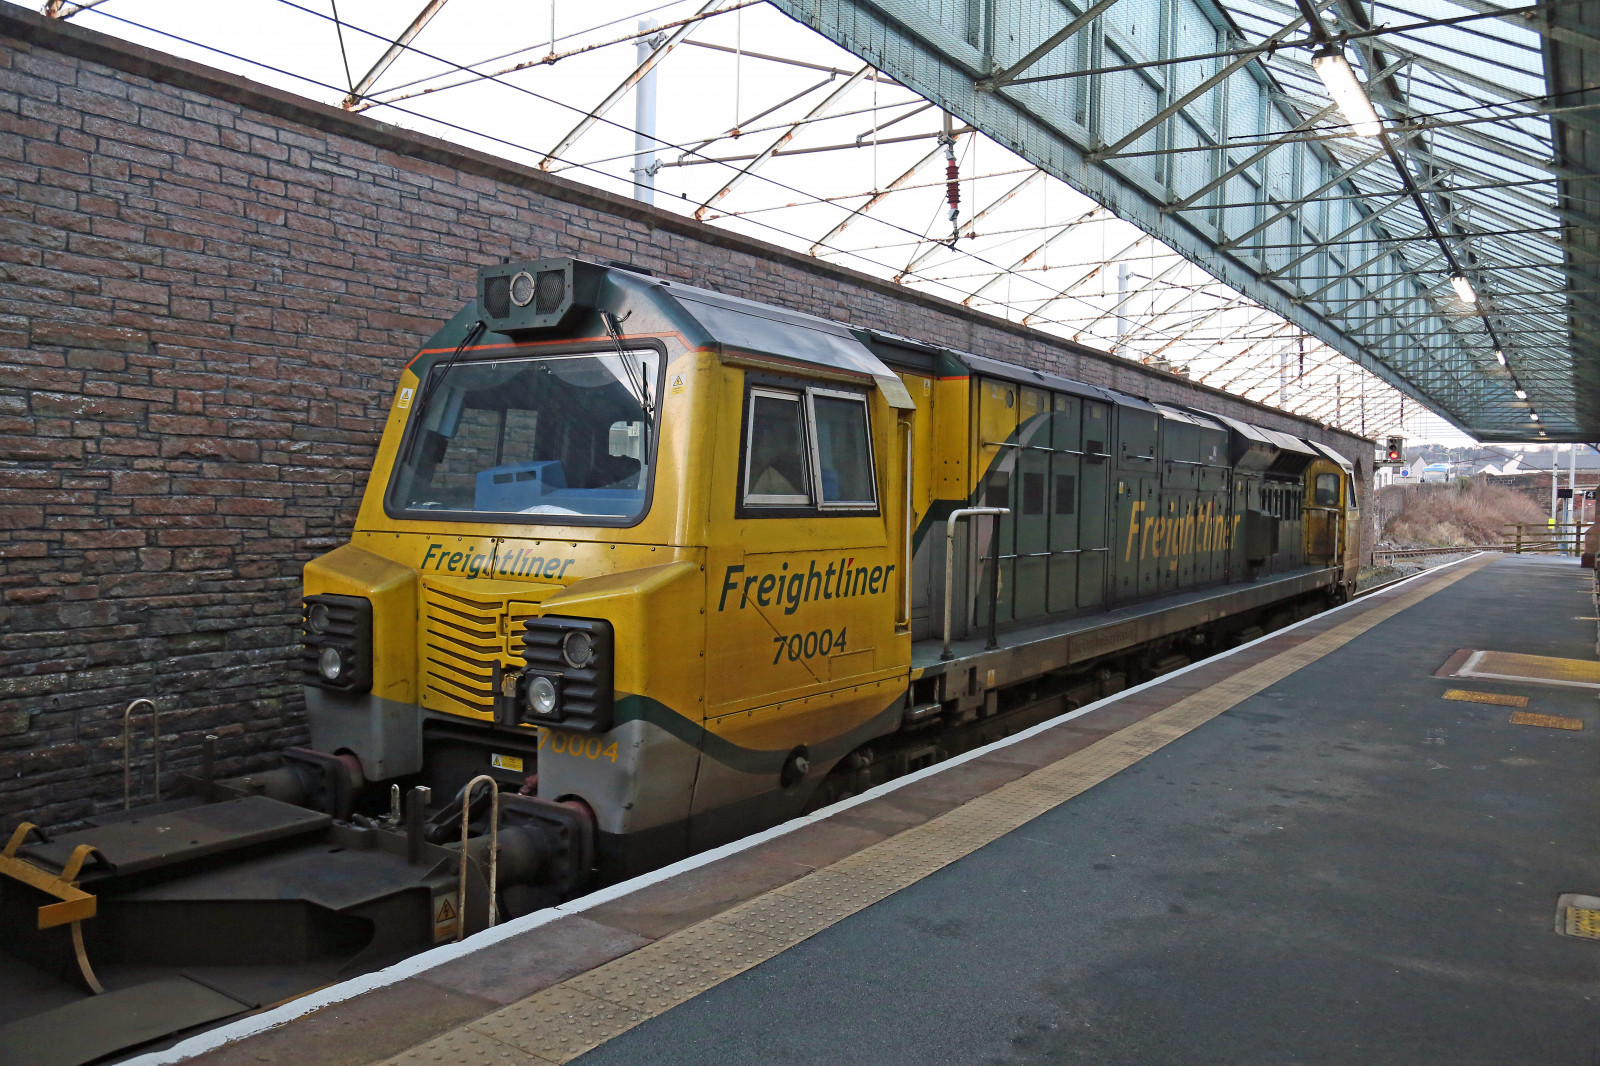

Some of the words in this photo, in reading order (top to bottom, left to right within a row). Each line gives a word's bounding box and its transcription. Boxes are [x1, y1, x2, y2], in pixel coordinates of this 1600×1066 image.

[1125, 501, 1241, 571] Freightliner
[420, 543, 575, 580] Freightliner
[718, 557, 896, 616] Freightliner
[773, 626, 847, 665] 70004
[537, 727, 619, 763] 70004
